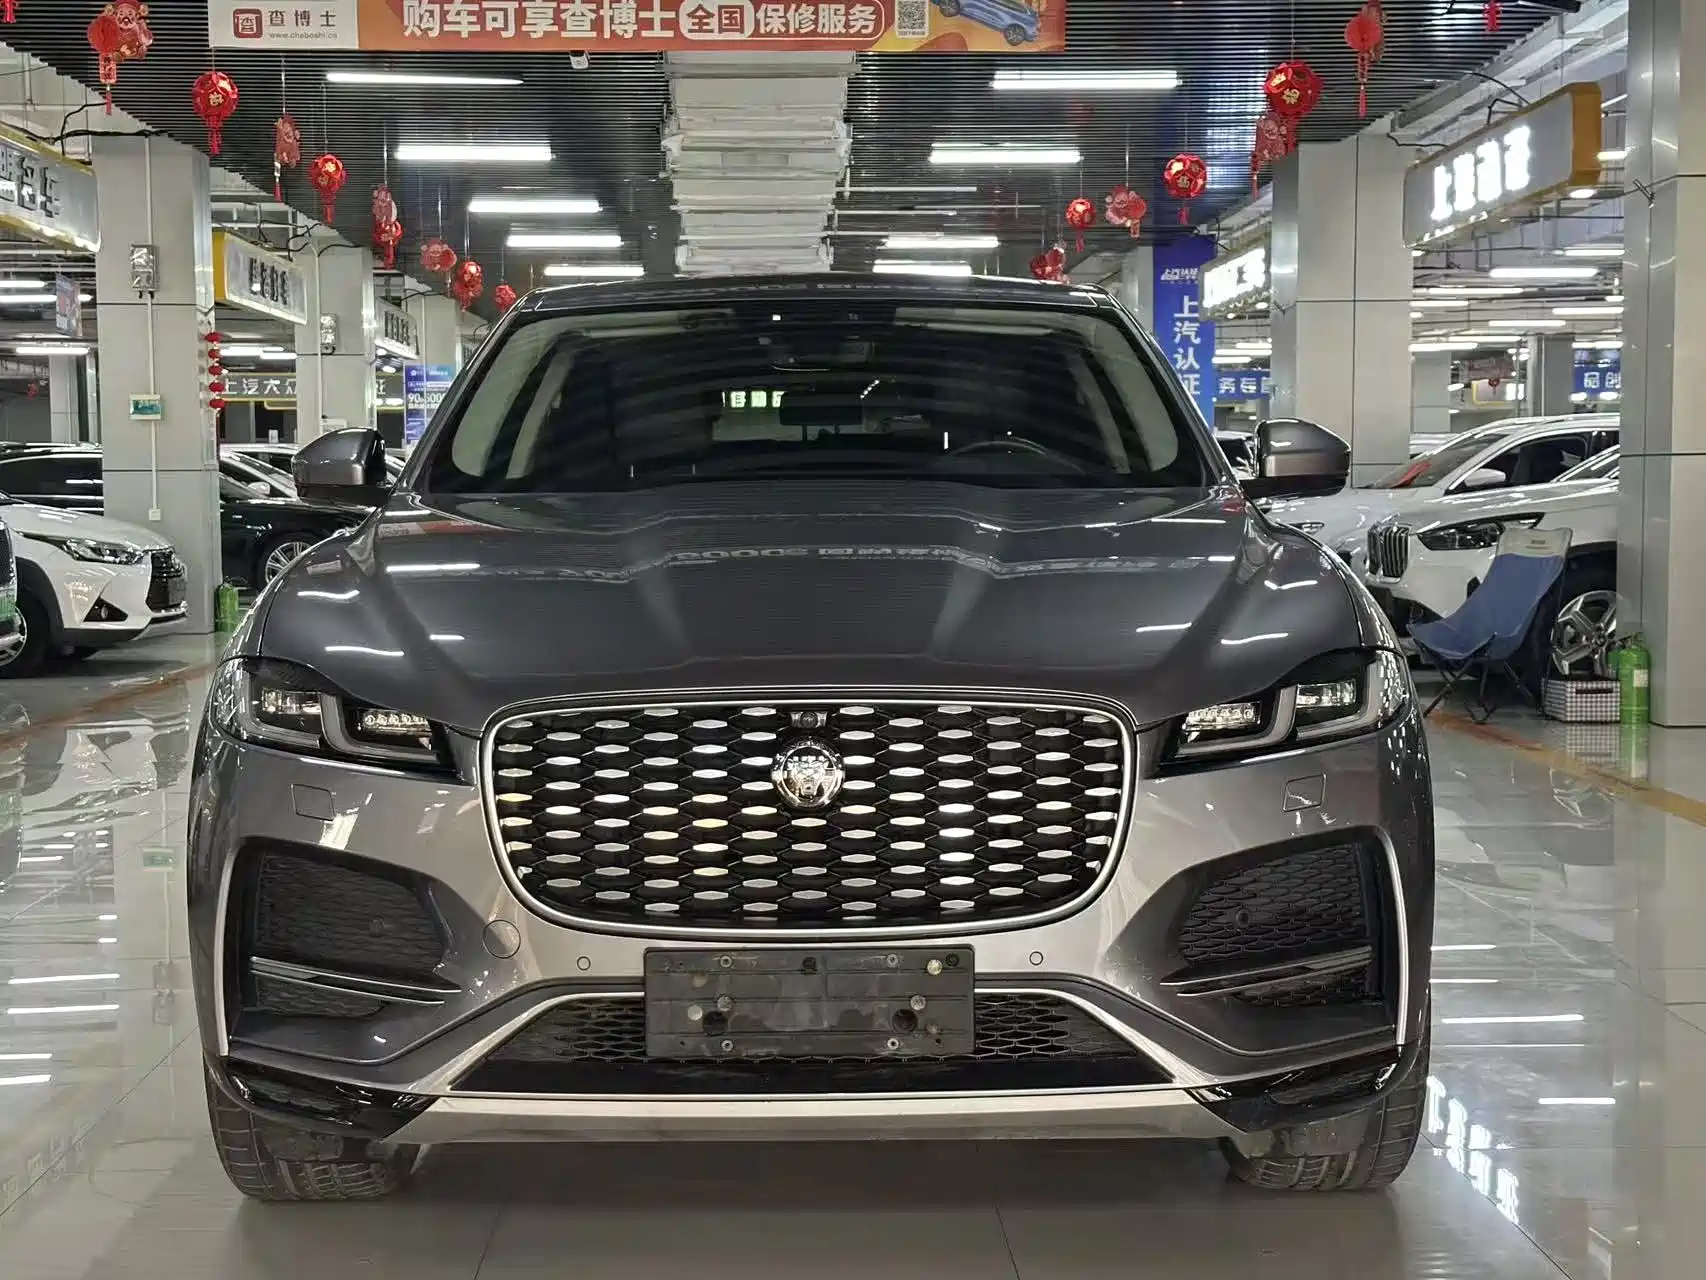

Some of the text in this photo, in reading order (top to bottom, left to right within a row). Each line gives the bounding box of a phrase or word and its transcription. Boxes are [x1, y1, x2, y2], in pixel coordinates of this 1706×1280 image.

[268, 9, 336, 28] 查博士
[403, 0, 878, 38] 购车可享查博士 全国 保修服务
